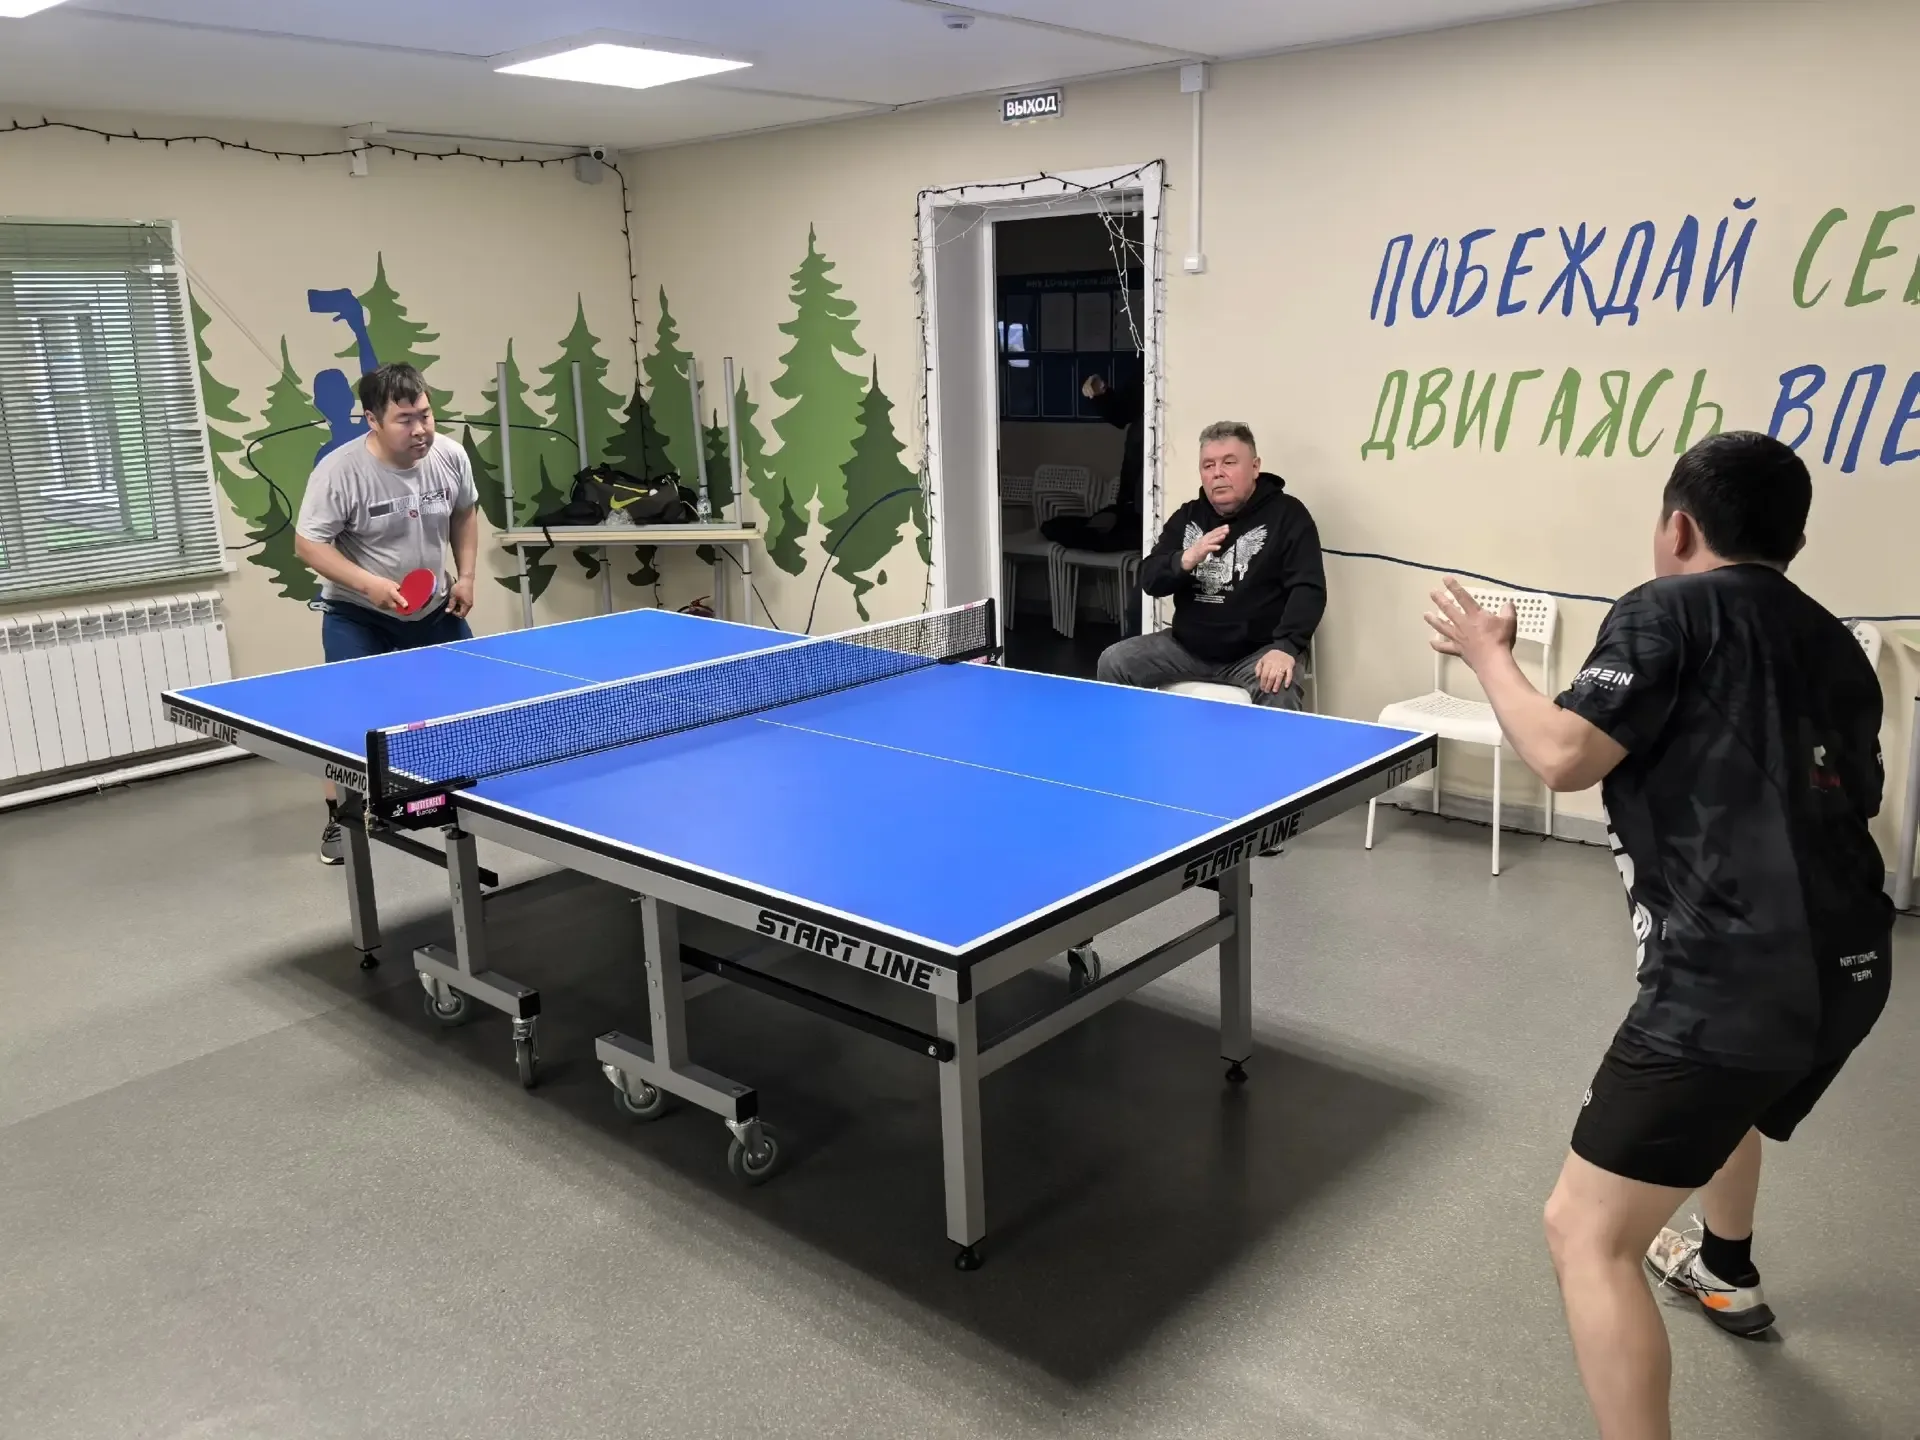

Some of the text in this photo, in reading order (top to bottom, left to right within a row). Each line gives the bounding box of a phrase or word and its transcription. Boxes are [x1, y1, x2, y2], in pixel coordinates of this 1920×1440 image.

[1006, 95, 1057, 117] ВЫХОД
[1370, 197, 1757, 327] ПОБЕЖДАЙ
[1361, 366, 1724, 461] ДВИГАЯСЬ
[170, 706, 239, 745] START LINE
[1387, 759, 1412, 789] ITTF
[410, 795, 442, 813] BUTTERFLY
[1181, 831, 1258, 890] START
[756, 909, 860, 963] START
[1839, 950, 1878, 967] NATIONAL
[1851, 969, 1873, 982] TEAM
